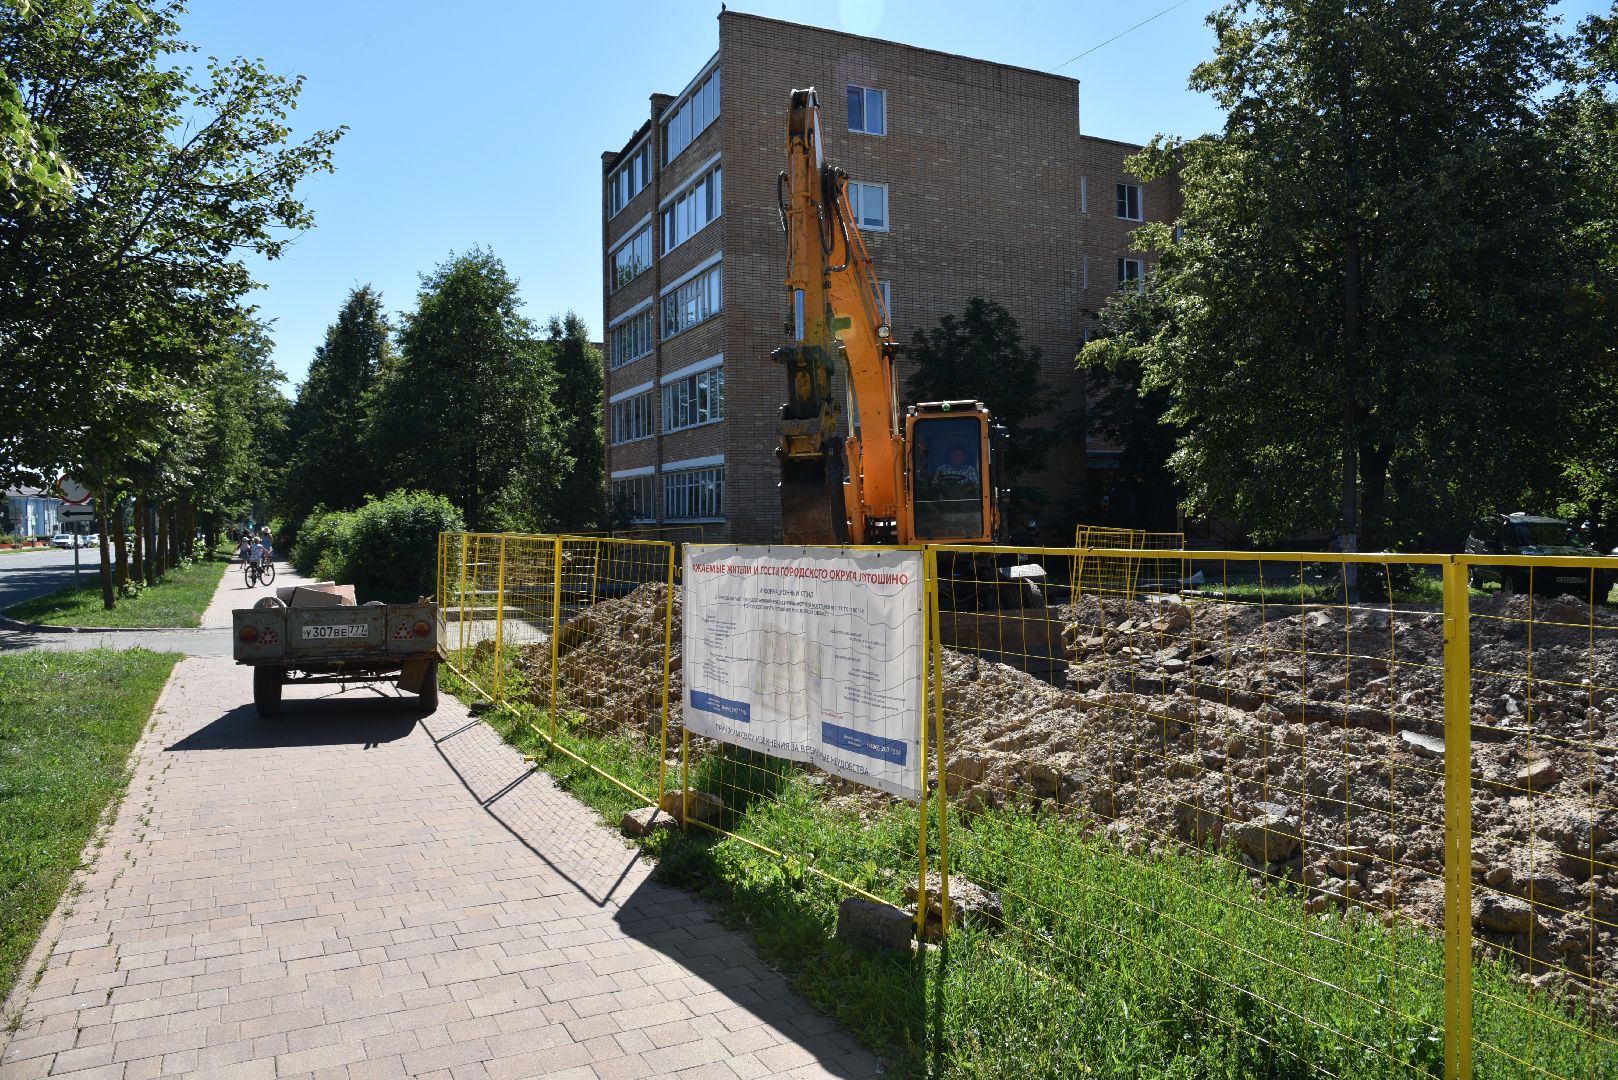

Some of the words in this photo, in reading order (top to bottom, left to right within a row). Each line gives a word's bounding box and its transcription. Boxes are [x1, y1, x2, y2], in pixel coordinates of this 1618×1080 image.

[760, 566, 779, 576] ГОСТИ
[780, 567, 828, 579] ГОРОДСКОГО
[829, 569, 857, 581] ОКРУГА
